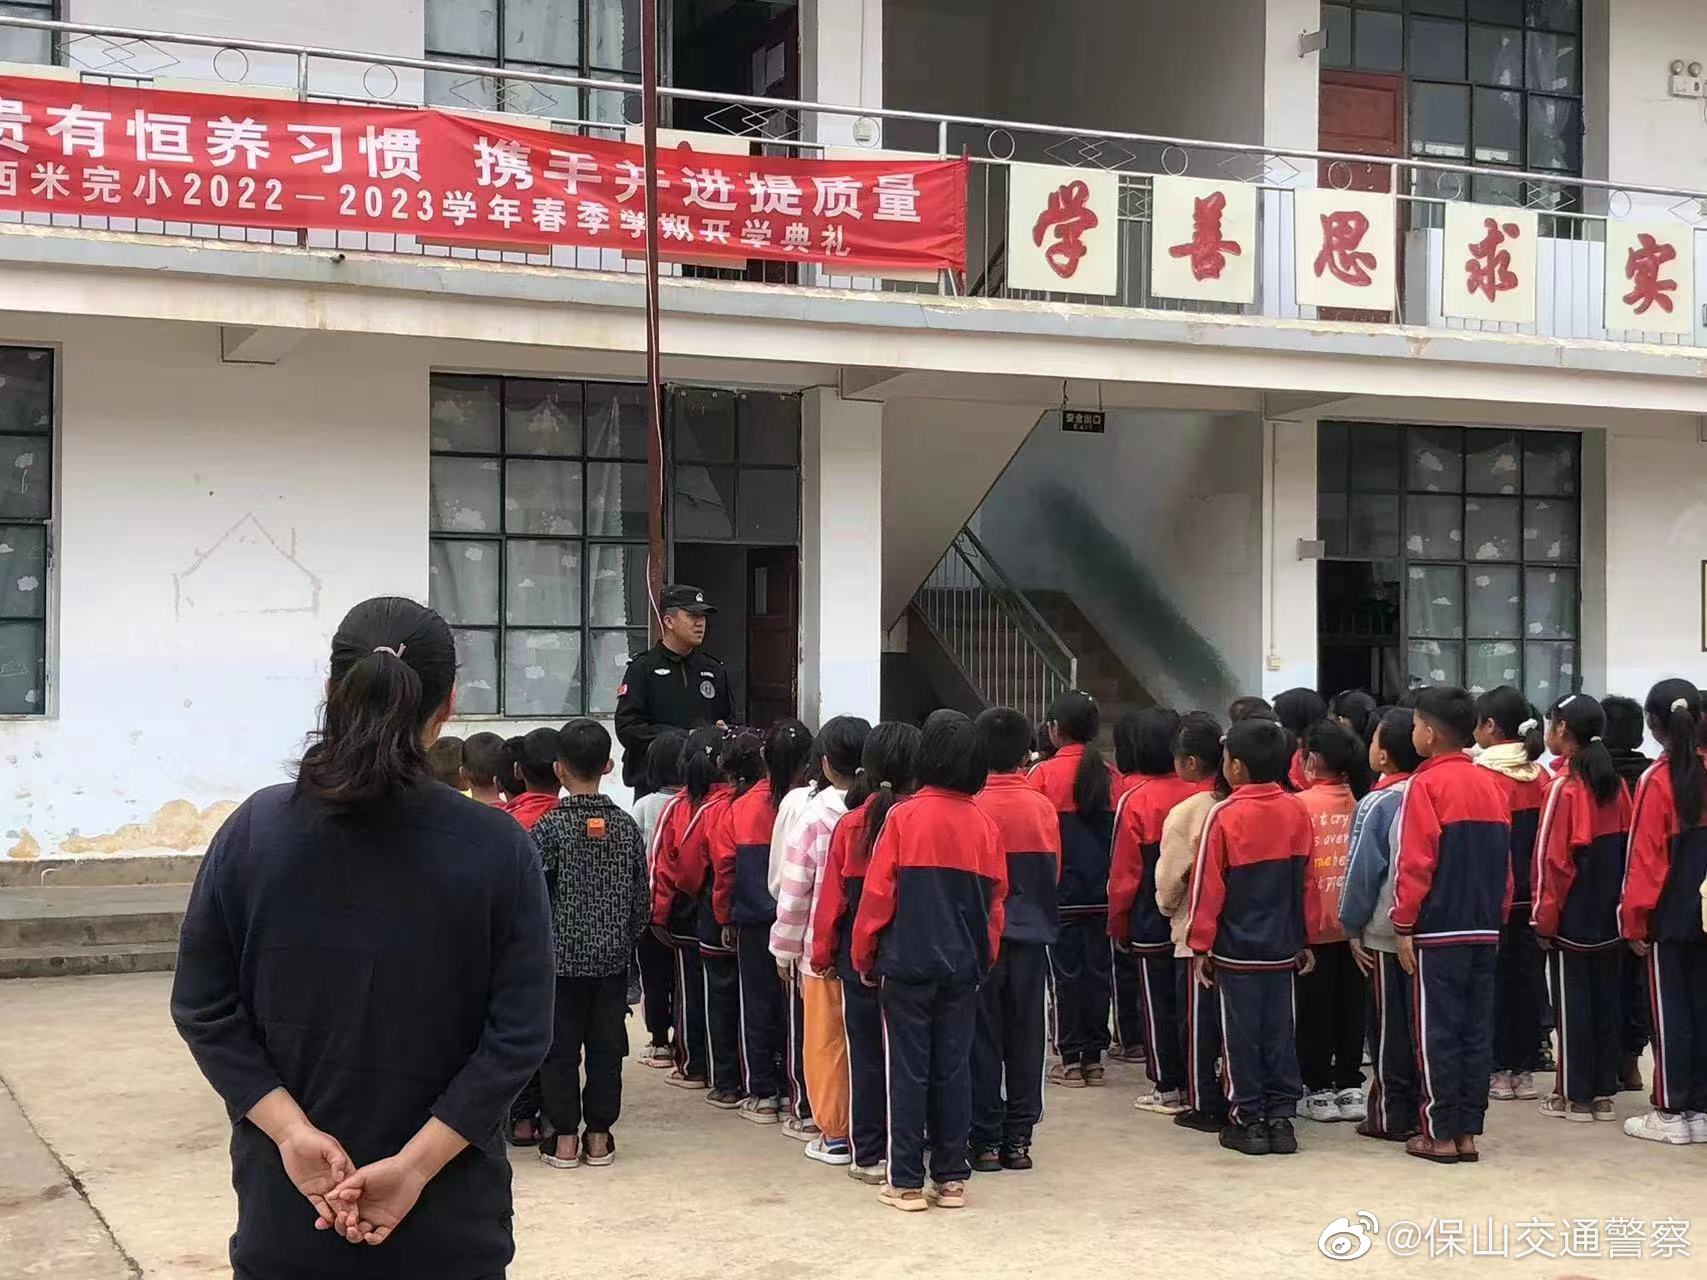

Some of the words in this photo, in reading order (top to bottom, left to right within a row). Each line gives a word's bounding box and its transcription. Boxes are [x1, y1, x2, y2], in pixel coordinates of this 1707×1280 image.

[473, 136, 922, 223] 携手并进提质量
